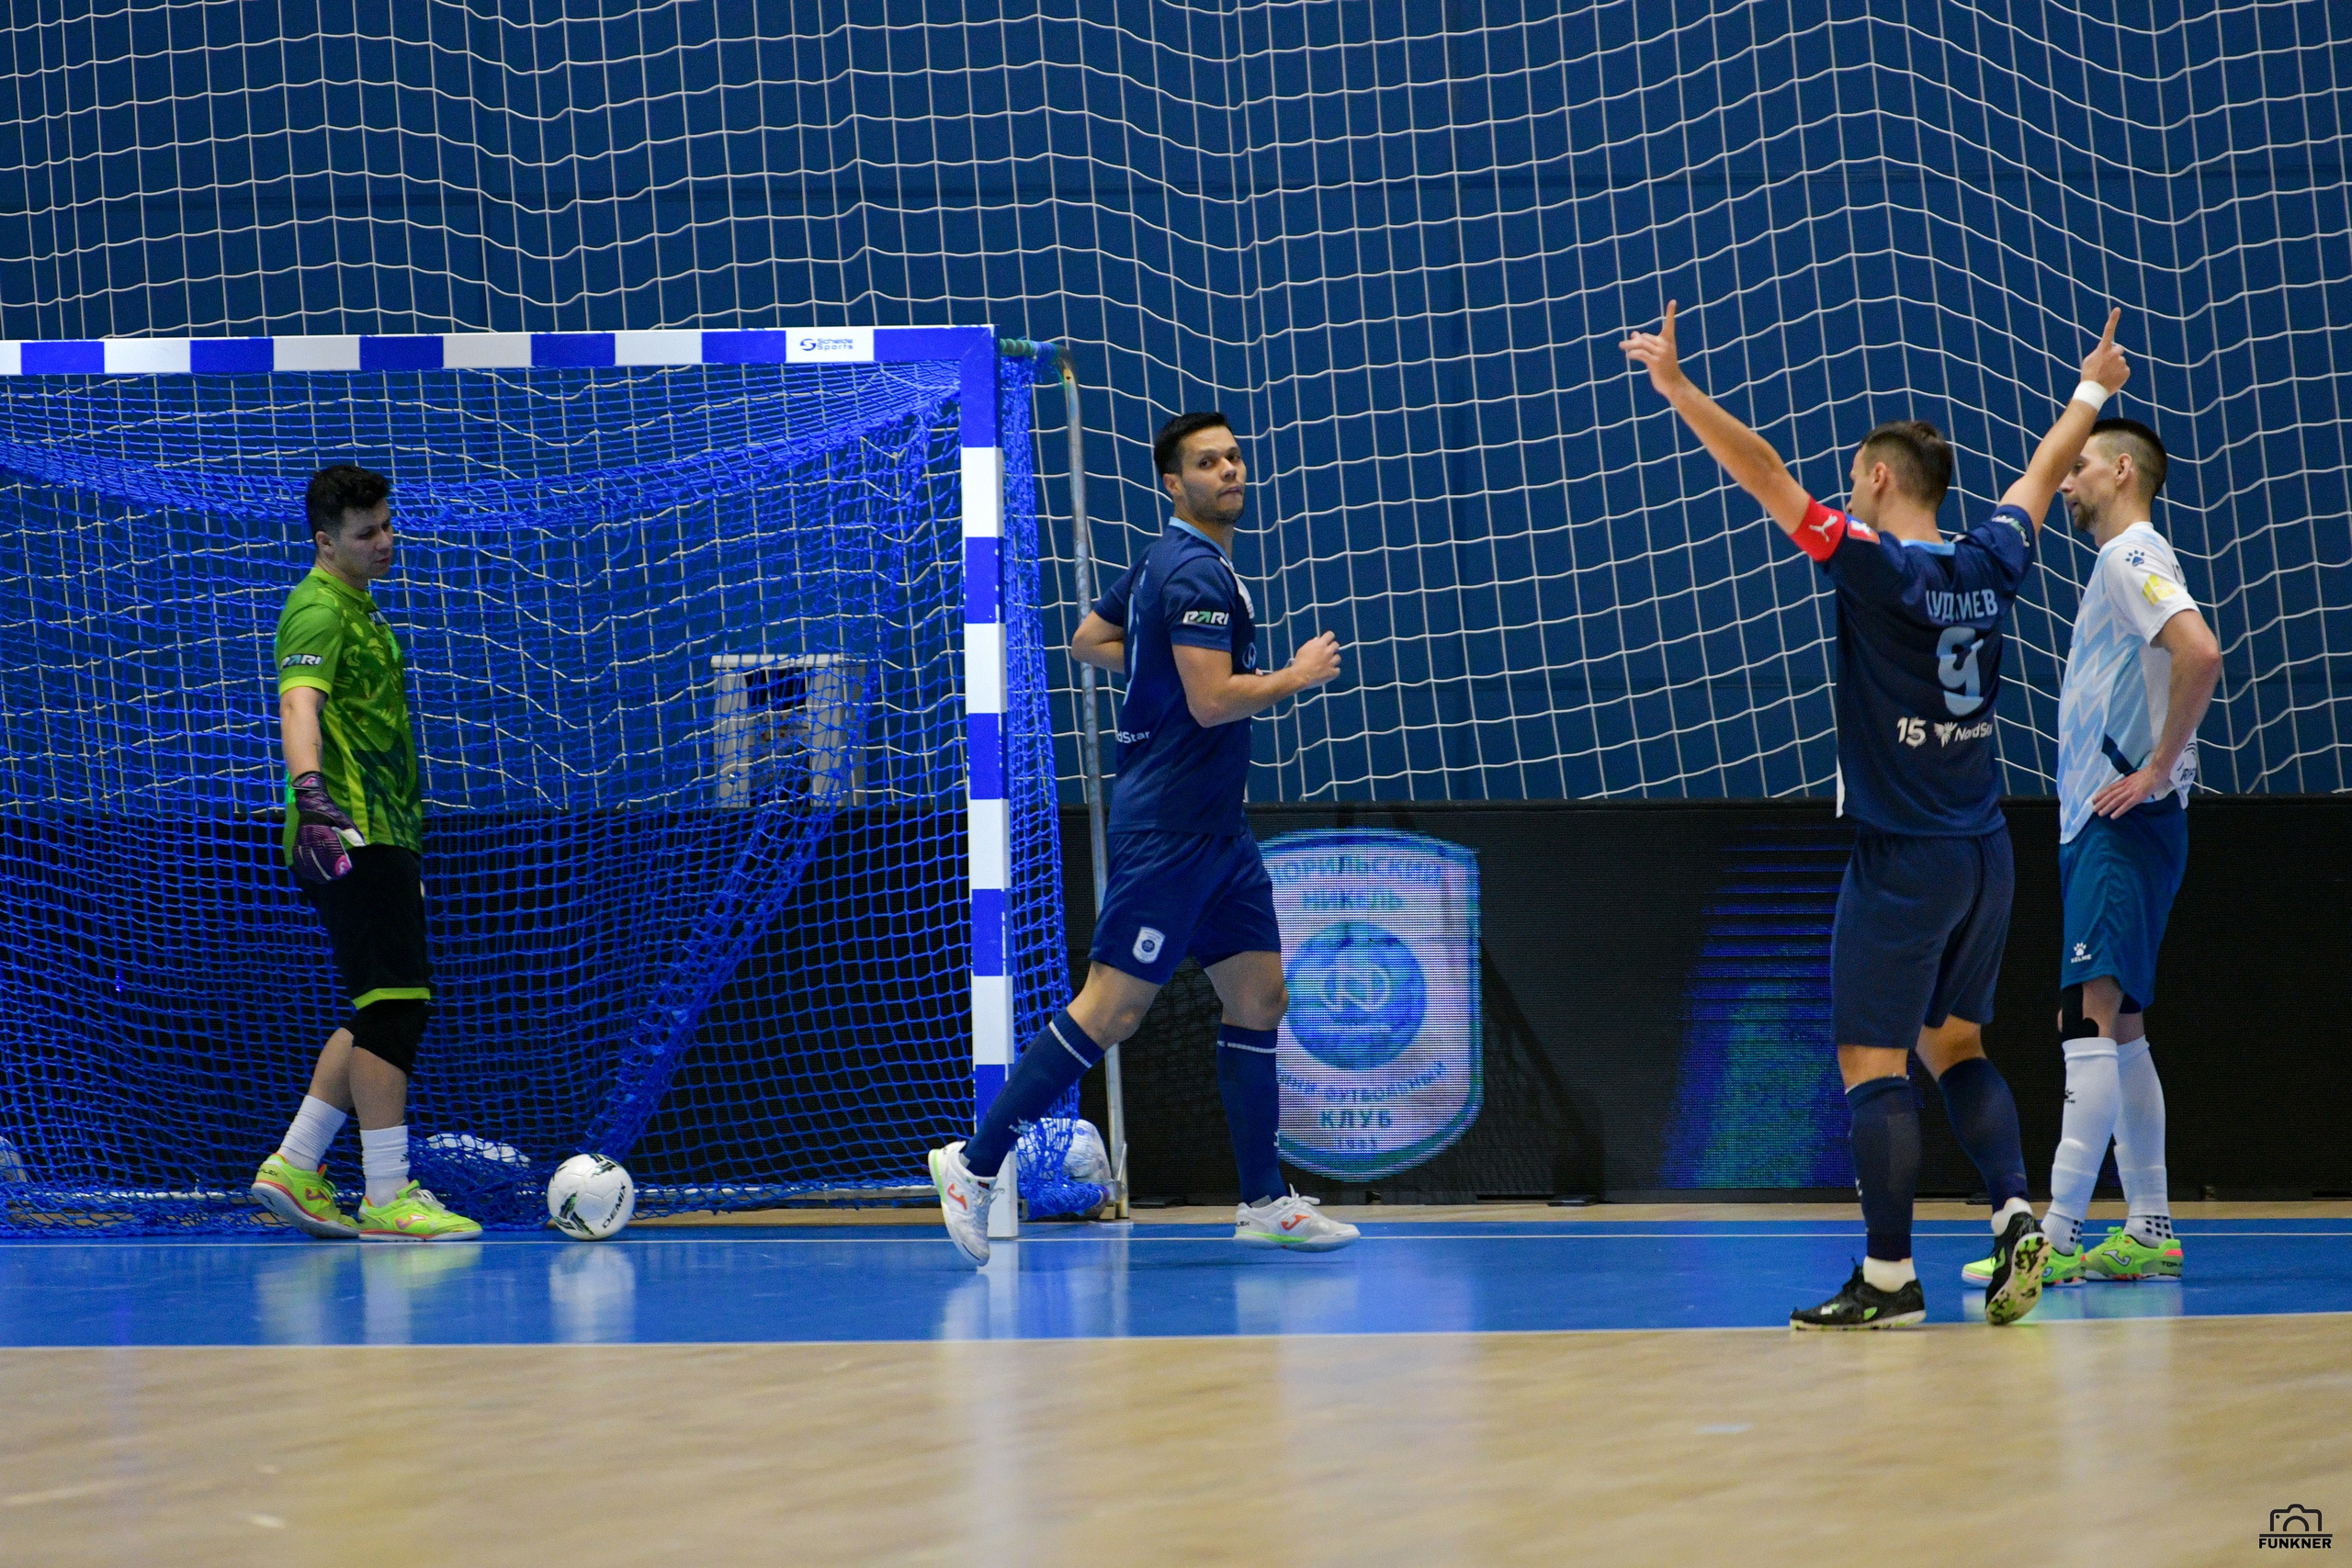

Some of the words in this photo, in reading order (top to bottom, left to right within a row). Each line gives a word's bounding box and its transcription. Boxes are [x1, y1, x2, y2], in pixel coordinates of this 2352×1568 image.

[1182, 610, 1229, 626] PARI
[1937, 626, 1984, 716] 9
[1117, 730, 1149, 744] dStar
[1897, 716, 1928, 749] 15
[1319, 1109, 1393, 1129] КЛУБ
